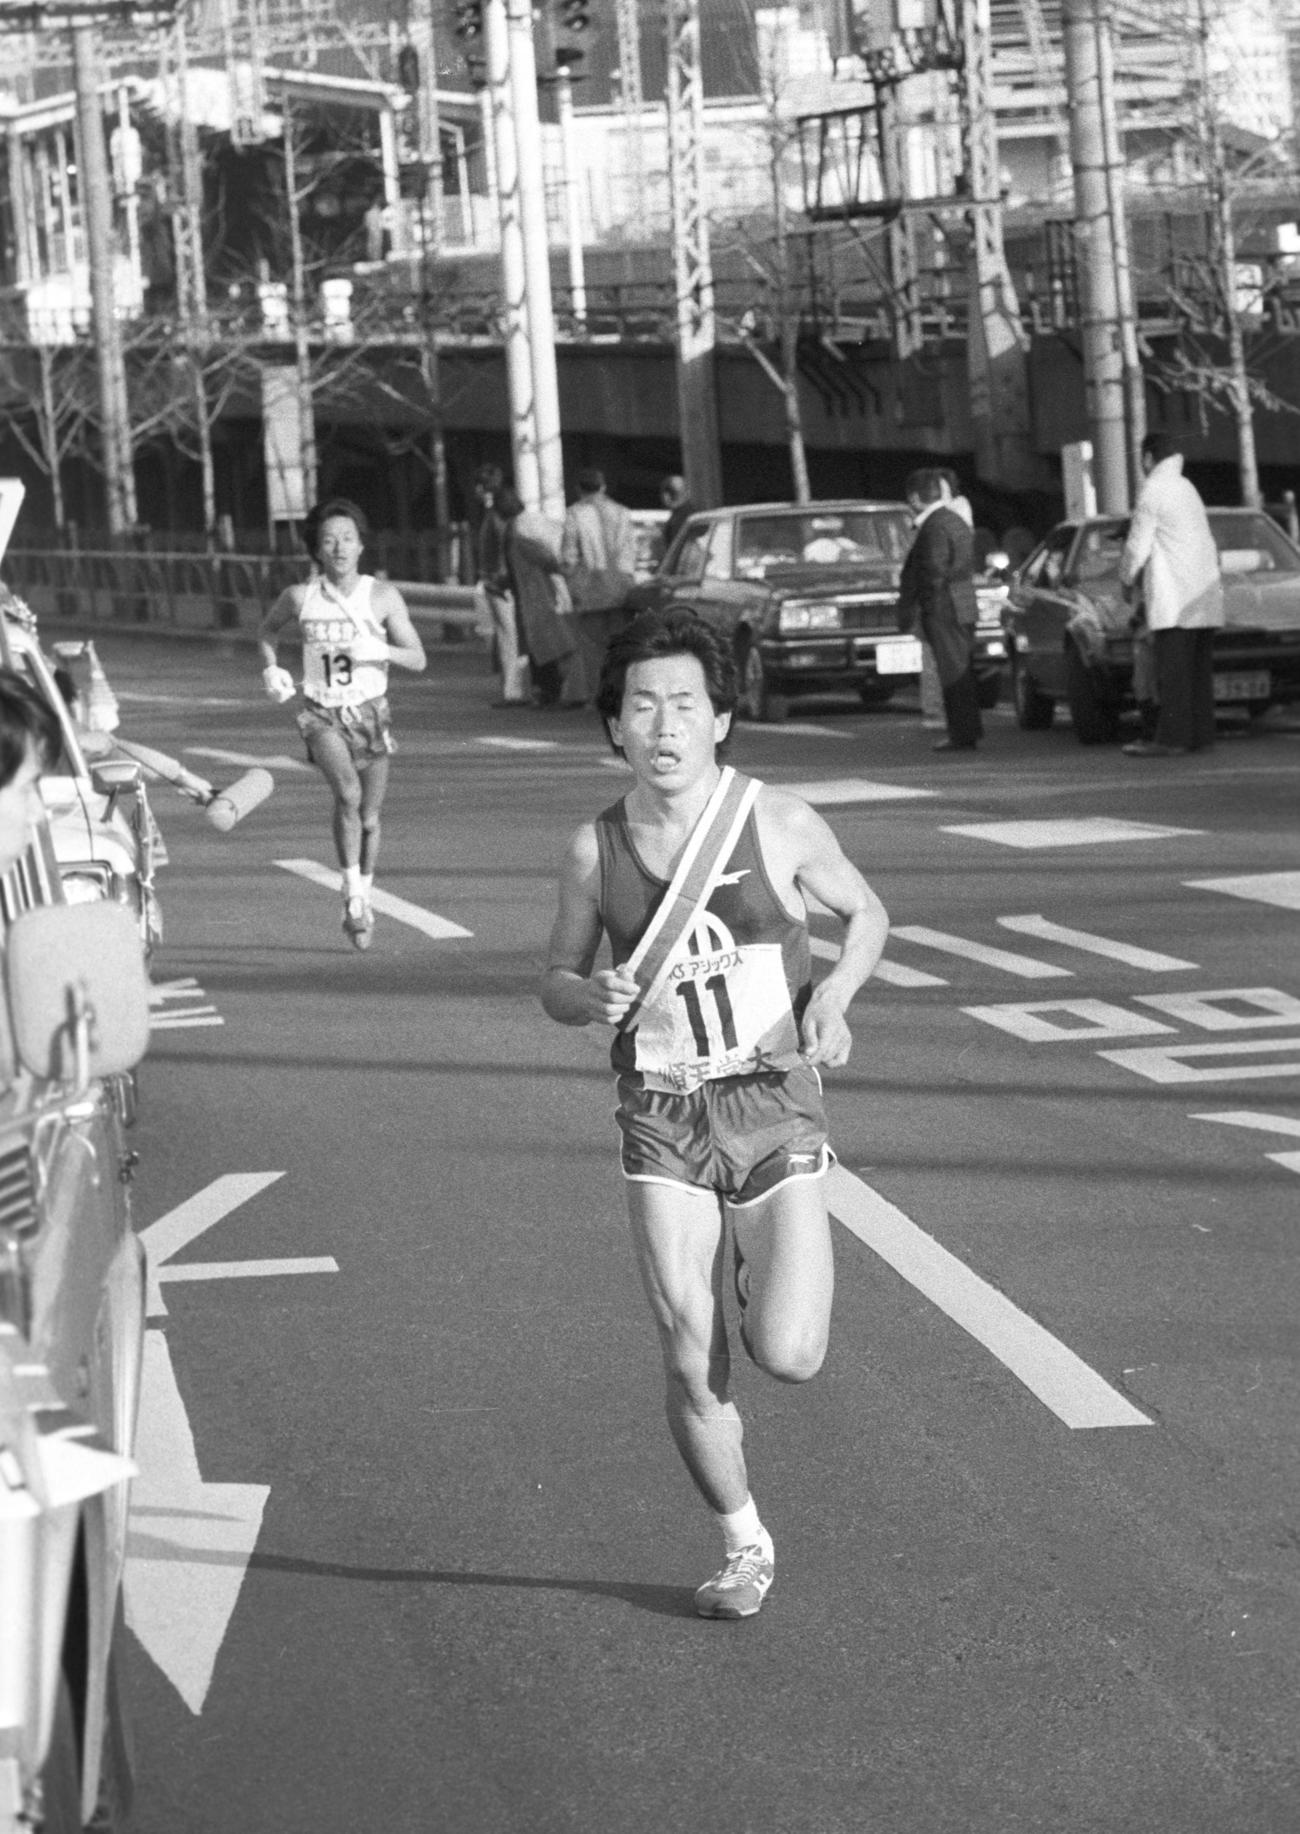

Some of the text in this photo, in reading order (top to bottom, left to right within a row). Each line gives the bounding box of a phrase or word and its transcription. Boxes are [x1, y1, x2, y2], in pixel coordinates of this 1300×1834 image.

[321, 653, 352, 688] 13
[688, 950, 744, 976] アシックス
[676, 973, 739, 1057] 11
